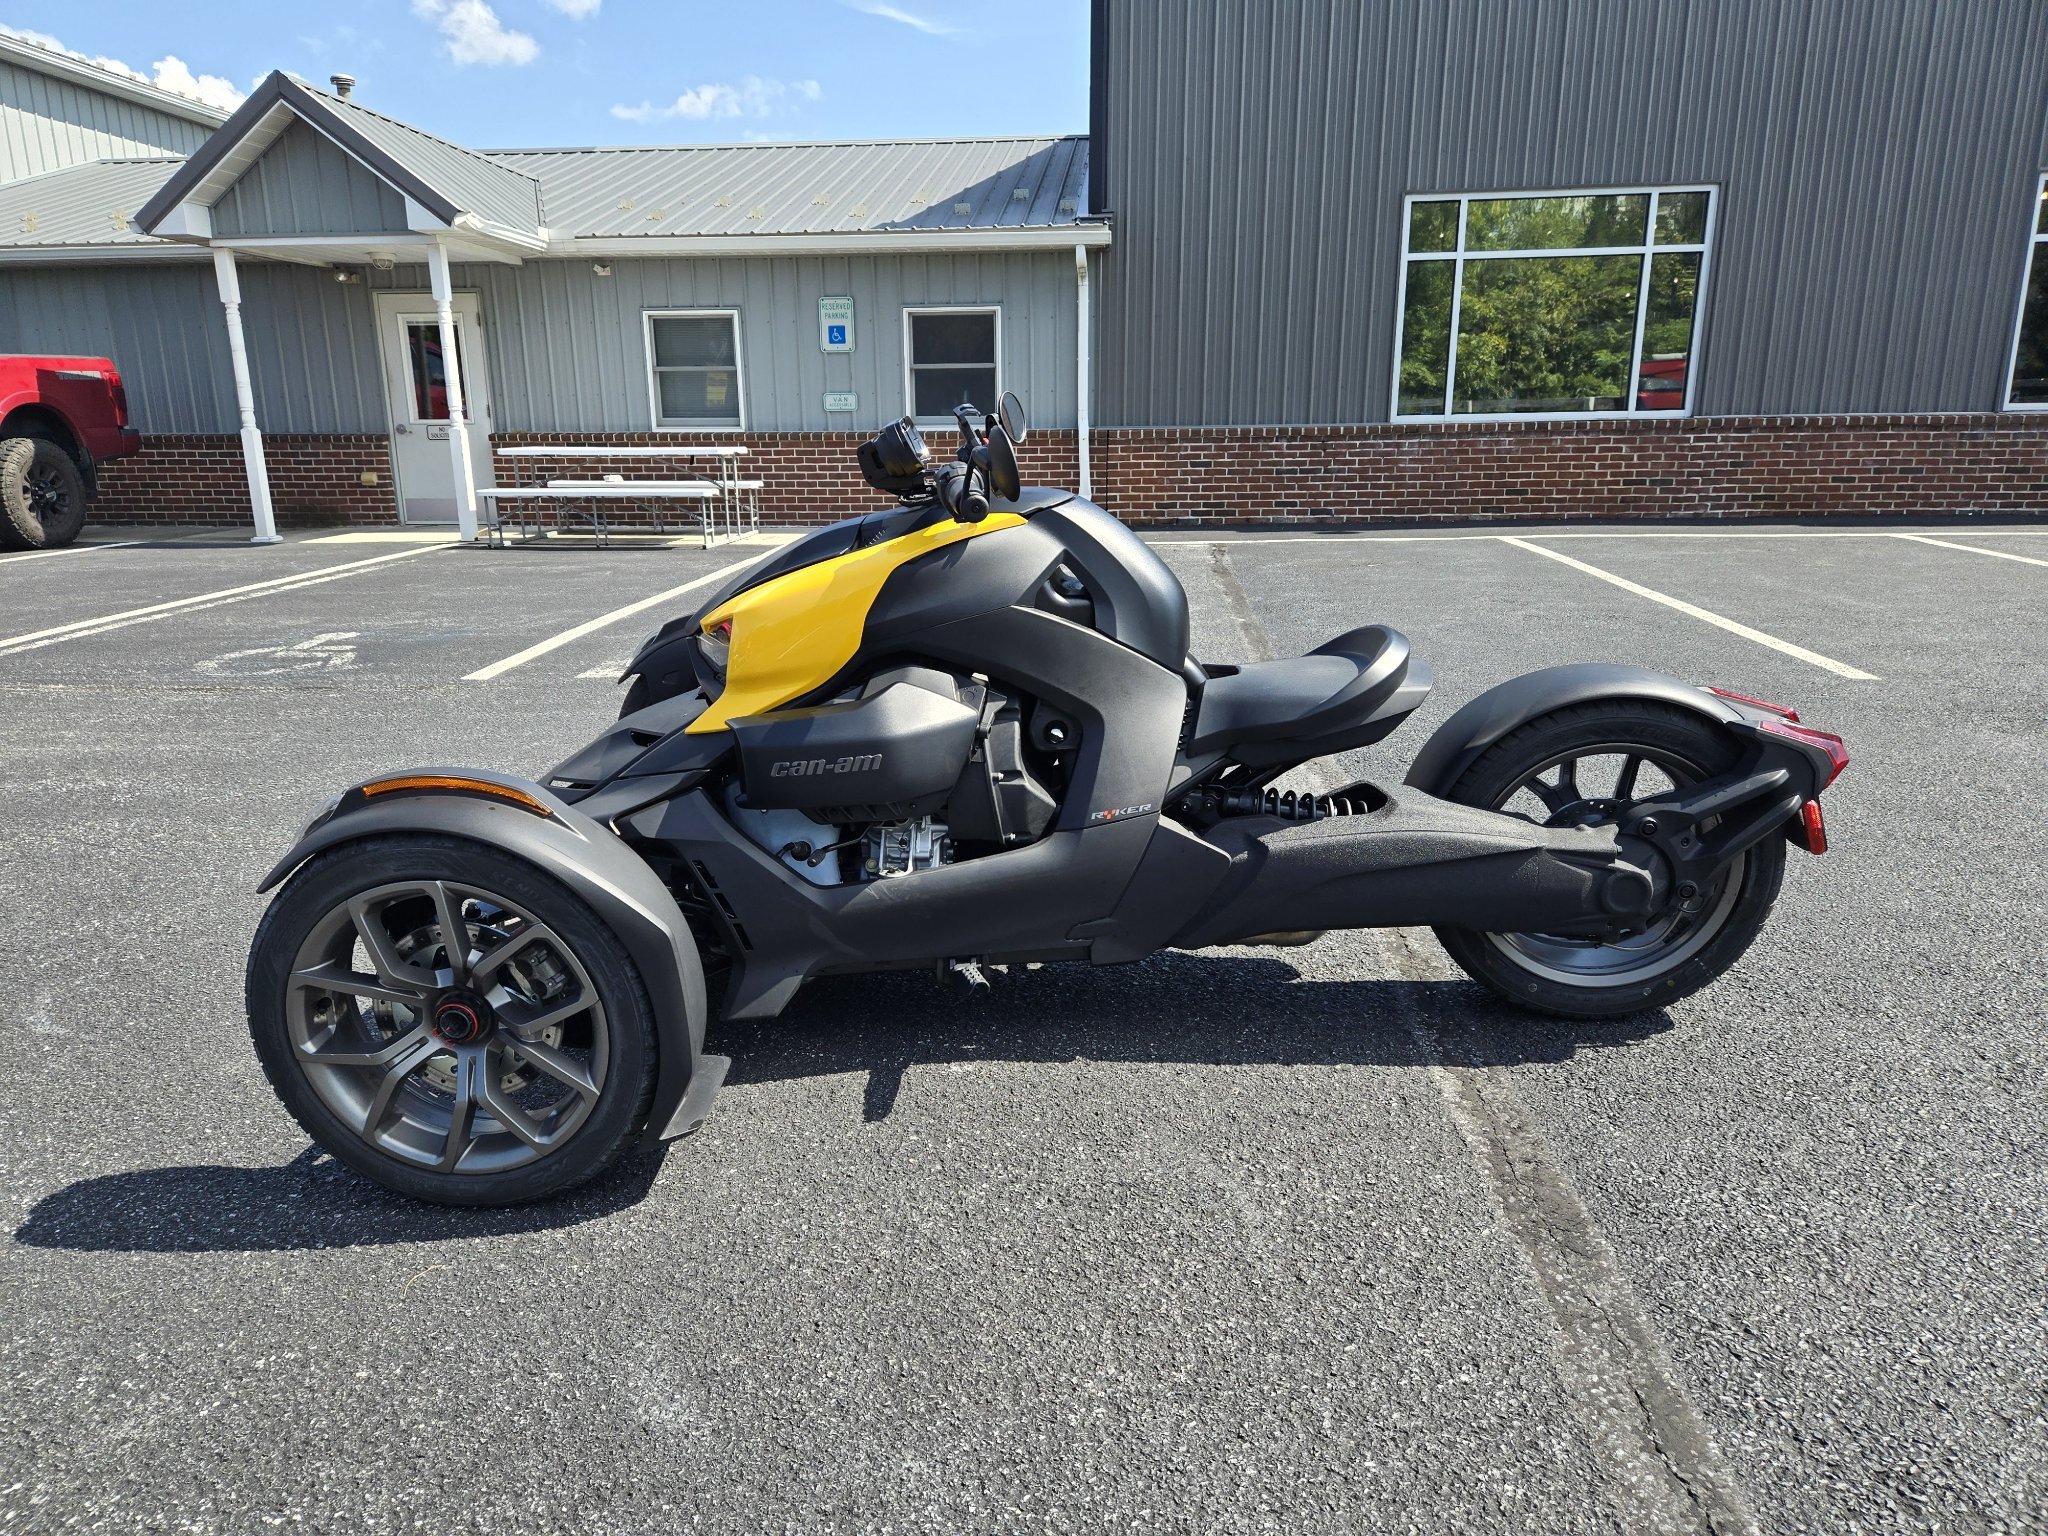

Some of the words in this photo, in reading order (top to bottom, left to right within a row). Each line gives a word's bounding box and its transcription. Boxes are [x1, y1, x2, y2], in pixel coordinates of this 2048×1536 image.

[821, 302, 851, 310] RESERVED
[824, 312, 849, 320] PARKING
[770, 753, 883, 777] can-am
[1091, 804, 1152, 820] RYKER
